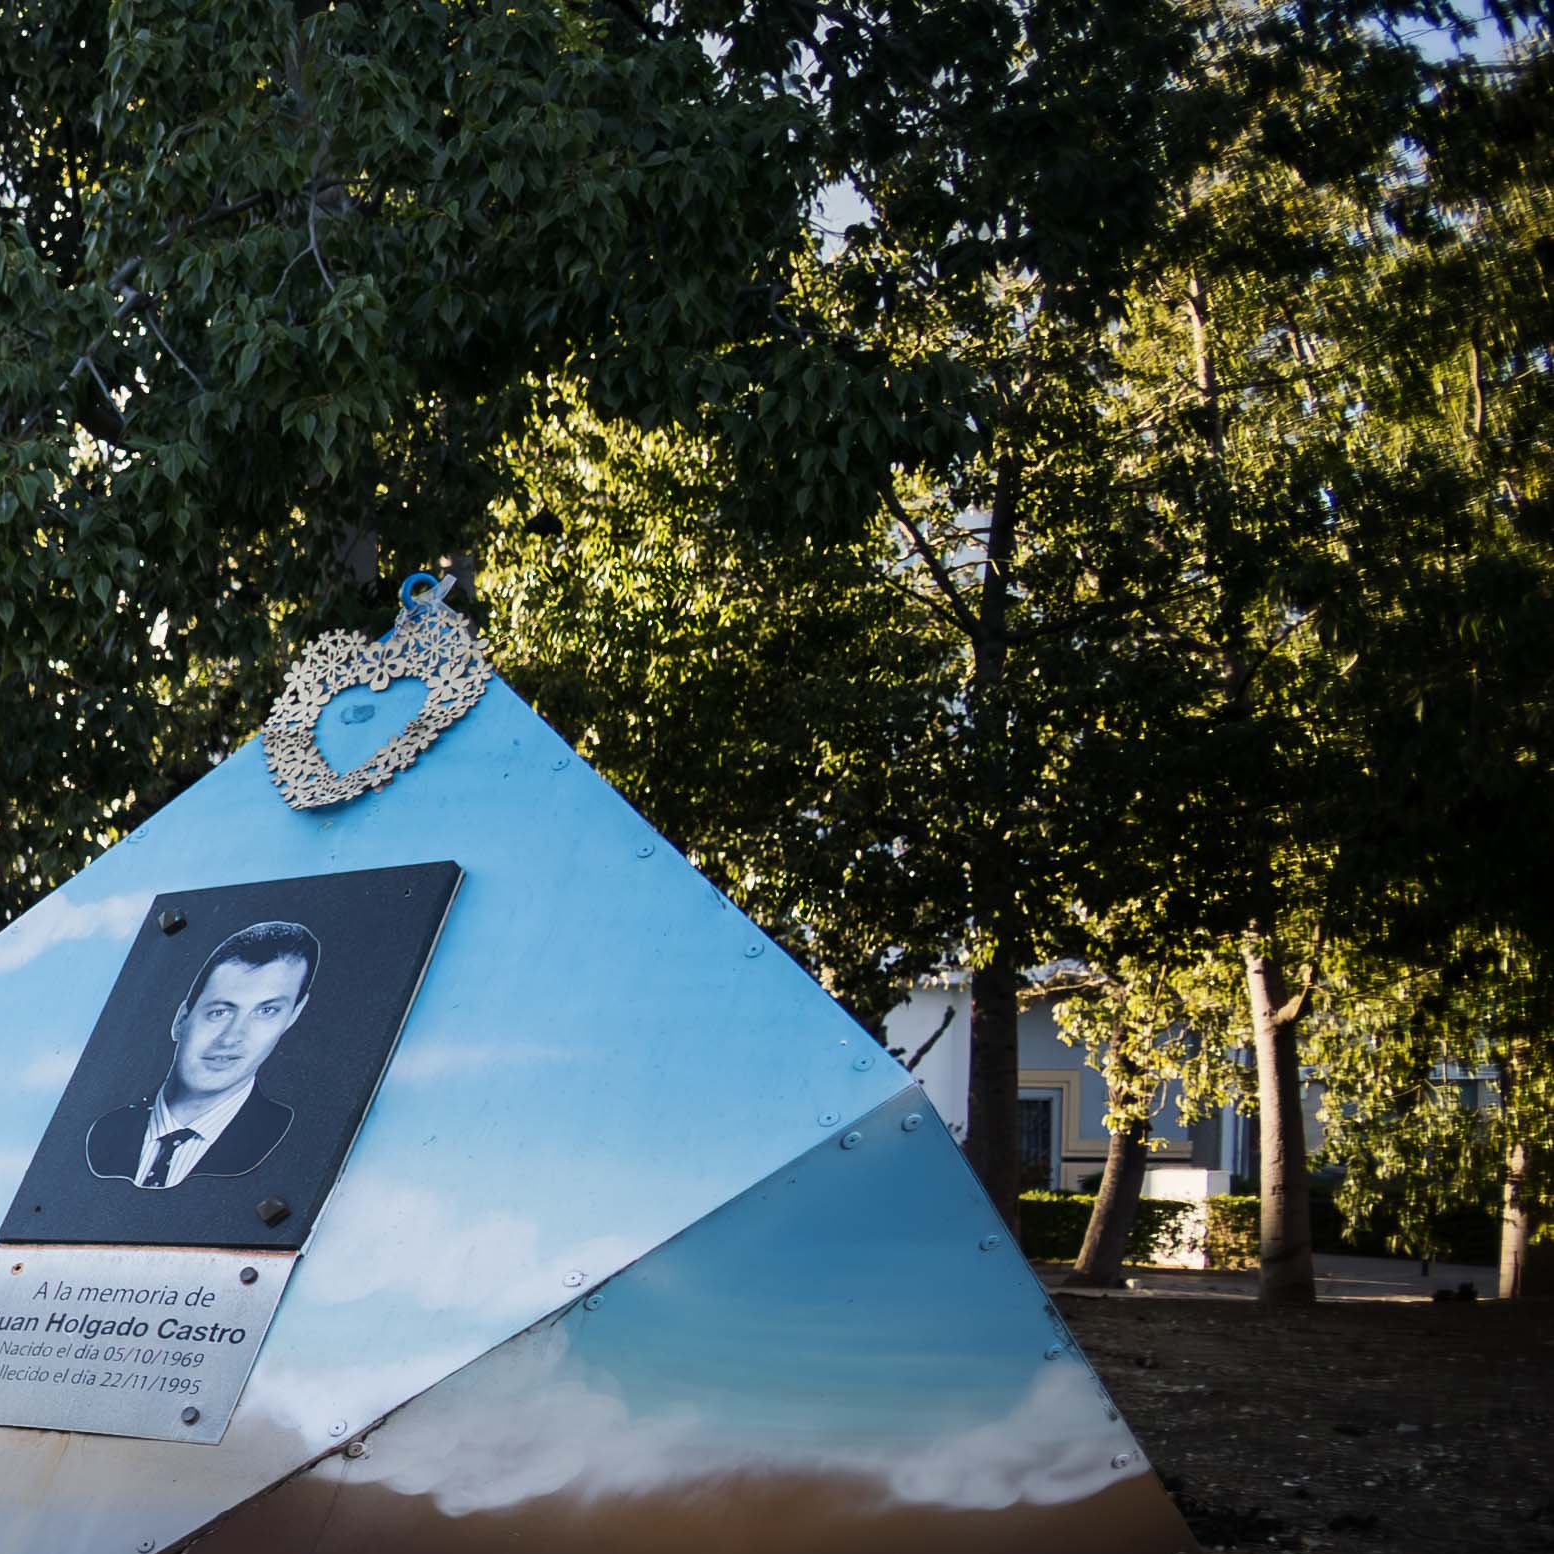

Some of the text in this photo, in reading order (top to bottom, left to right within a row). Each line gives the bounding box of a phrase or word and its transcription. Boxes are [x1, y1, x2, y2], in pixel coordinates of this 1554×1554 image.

[32, 1281, 216, 1308] A la memoria de
[45, 1312, 149, 1339] Holgado
[157, 1318, 247, 1345] Castro
[56, 1343, 73, 1358] el
[103, 1346, 205, 1368] 05/10/1969
[53, 1367, 70, 1383] el
[99, 1371, 203, 1395] 22/11/1995
